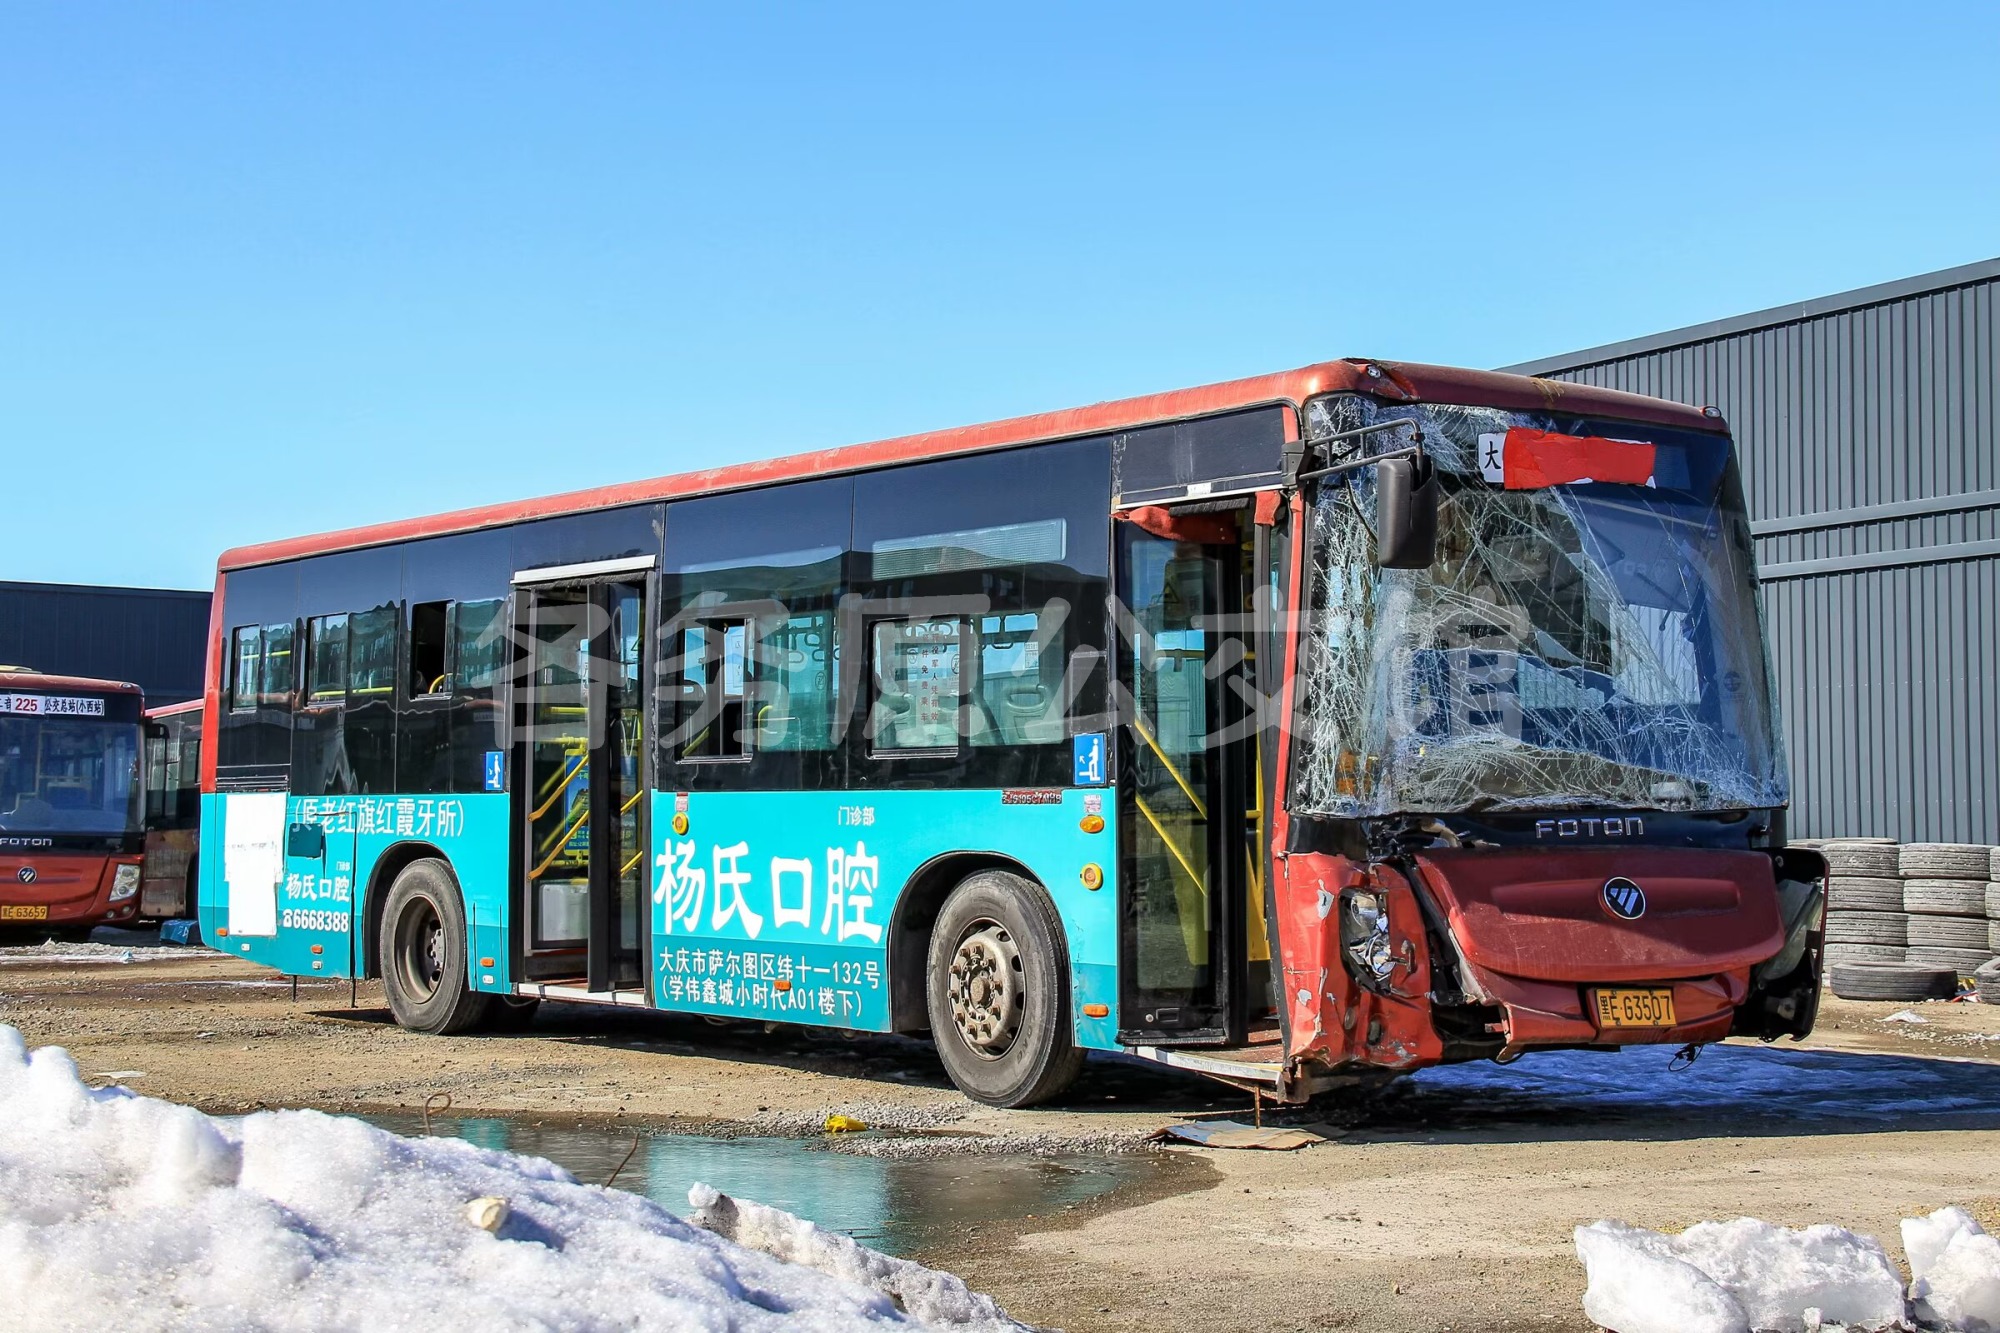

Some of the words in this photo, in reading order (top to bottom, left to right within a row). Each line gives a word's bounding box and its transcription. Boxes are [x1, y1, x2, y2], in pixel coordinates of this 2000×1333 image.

[1484, 440, 1502, 469] 大
[15, 697, 38, 712] 225
[838, 806, 875, 826] 门诊部
[1535, 817, 1644, 839] FOTON
[0, 837, 52, 847] FOTON
[286, 872, 350, 902] 杨氏口腔
[654, 838, 883, 944] 杨氏口腔
[293, 908, 349, 933] 6668388
